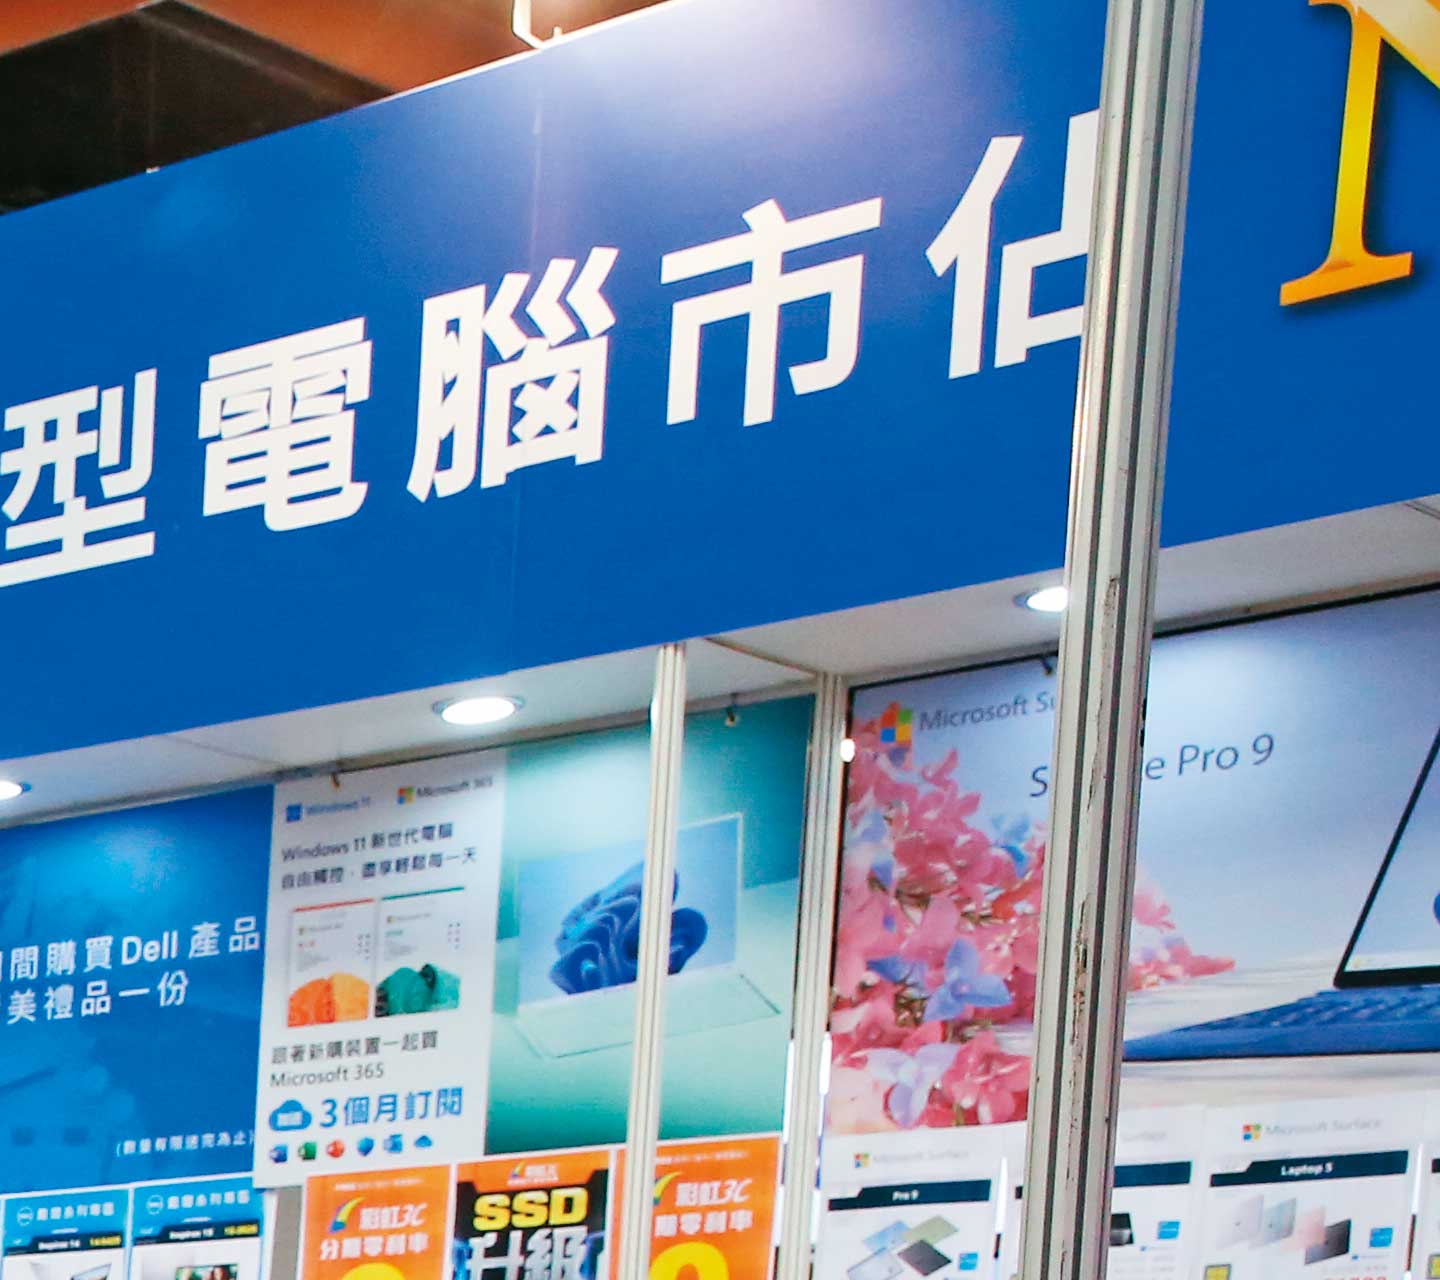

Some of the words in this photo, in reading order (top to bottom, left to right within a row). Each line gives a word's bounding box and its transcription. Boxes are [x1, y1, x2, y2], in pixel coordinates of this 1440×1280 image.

[919, 695, 1031, 732] Microsoft
[1180, 745, 1238, 776] Pro
[1253, 733, 1274, 766] 9
[281, 843, 349, 862] Windows
[354, 837, 367, 851] 11
[270, 1064, 347, 1088] Microsoft
[353, 1062, 384, 1081] 365
[319, 1087, 463, 1128] 3個月訂閱
[1281, 1163, 1323, 1178] Laptop
[676, 1180, 752, 1207] 彩虹3C
[359, 1202, 428, 1230] 彩虹3C
[473, 1187, 588, 1232] SSD
